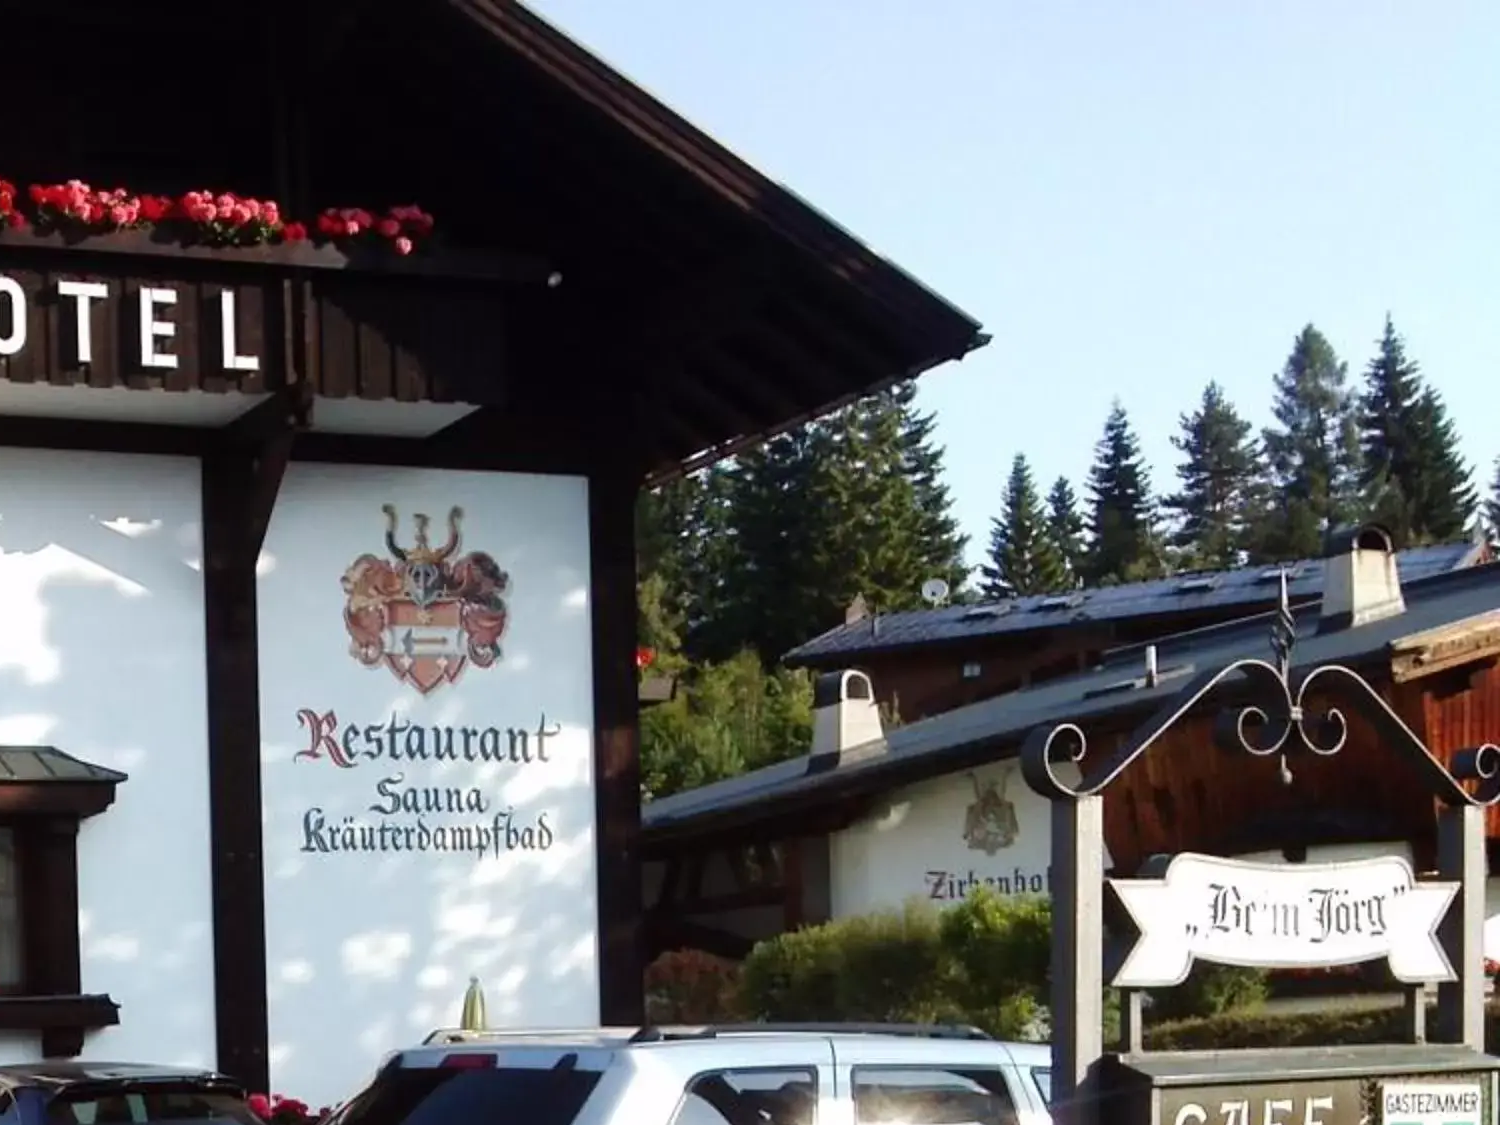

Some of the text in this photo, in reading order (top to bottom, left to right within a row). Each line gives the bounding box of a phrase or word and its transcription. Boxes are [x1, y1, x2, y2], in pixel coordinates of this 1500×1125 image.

[294, 708, 561, 768] Restaurant
[369, 772, 489, 815] Sauna
[300, 806, 553, 859] Kräuterdampfbad
